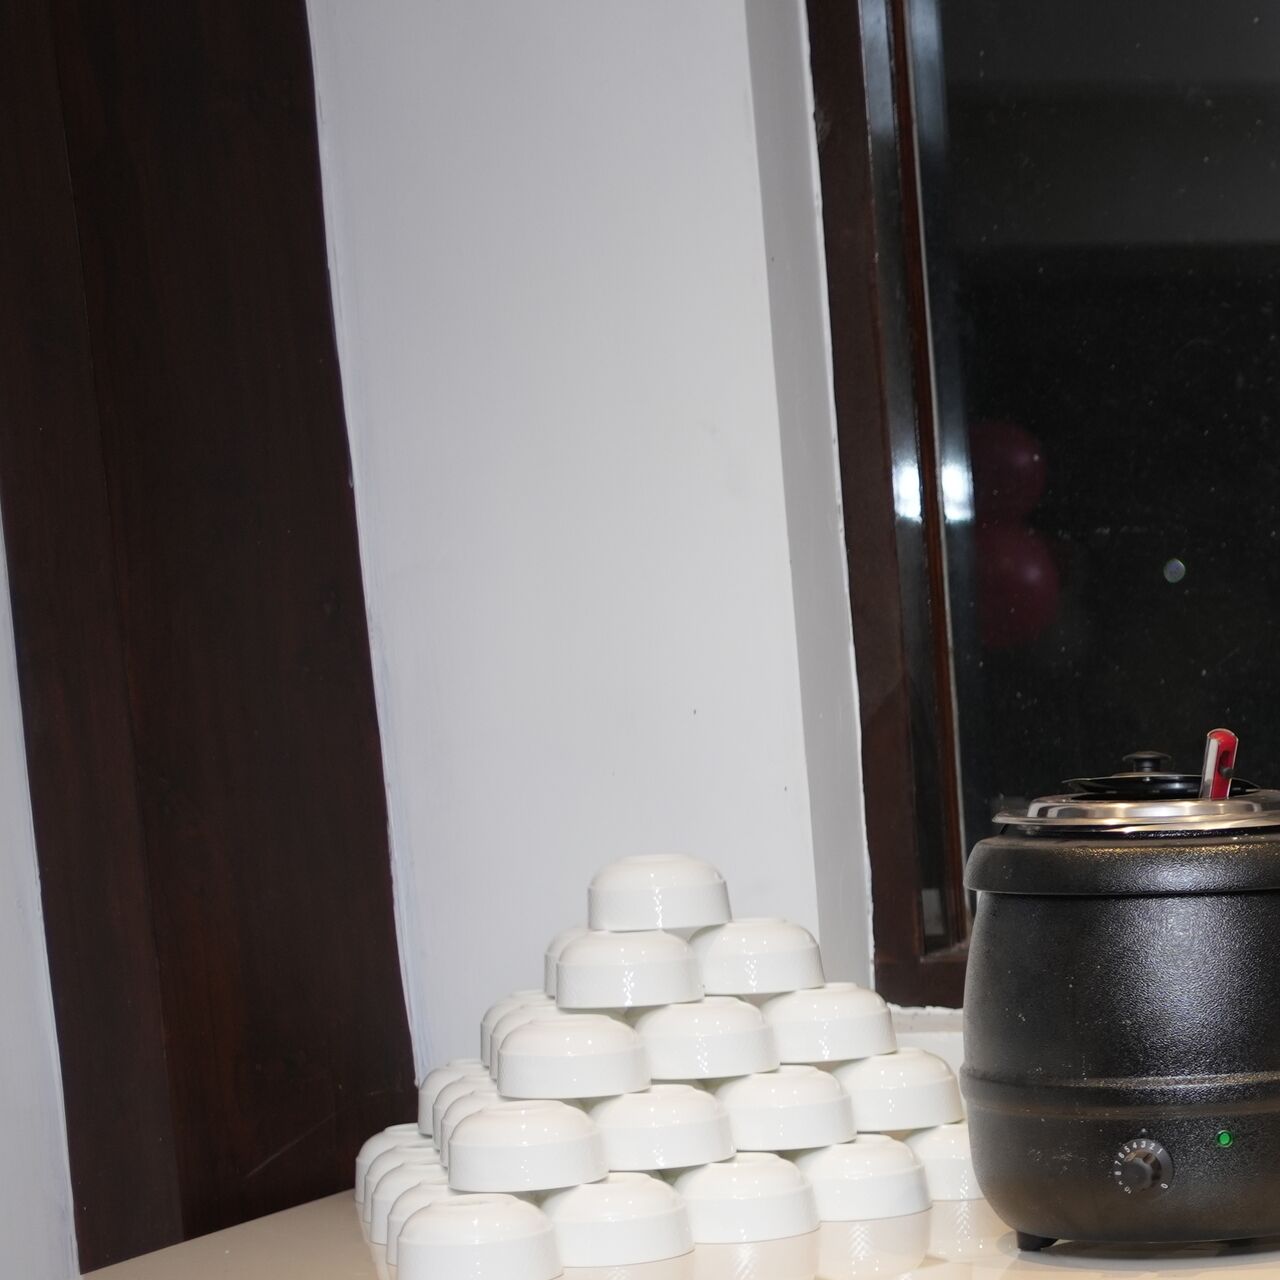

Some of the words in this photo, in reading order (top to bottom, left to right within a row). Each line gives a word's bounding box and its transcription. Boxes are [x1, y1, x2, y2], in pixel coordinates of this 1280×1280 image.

[1124, 1145, 1131, 1153] 5
[1132, 1141, 1137, 1149] 4
[1141, 1140, 1146, 1148] 3
